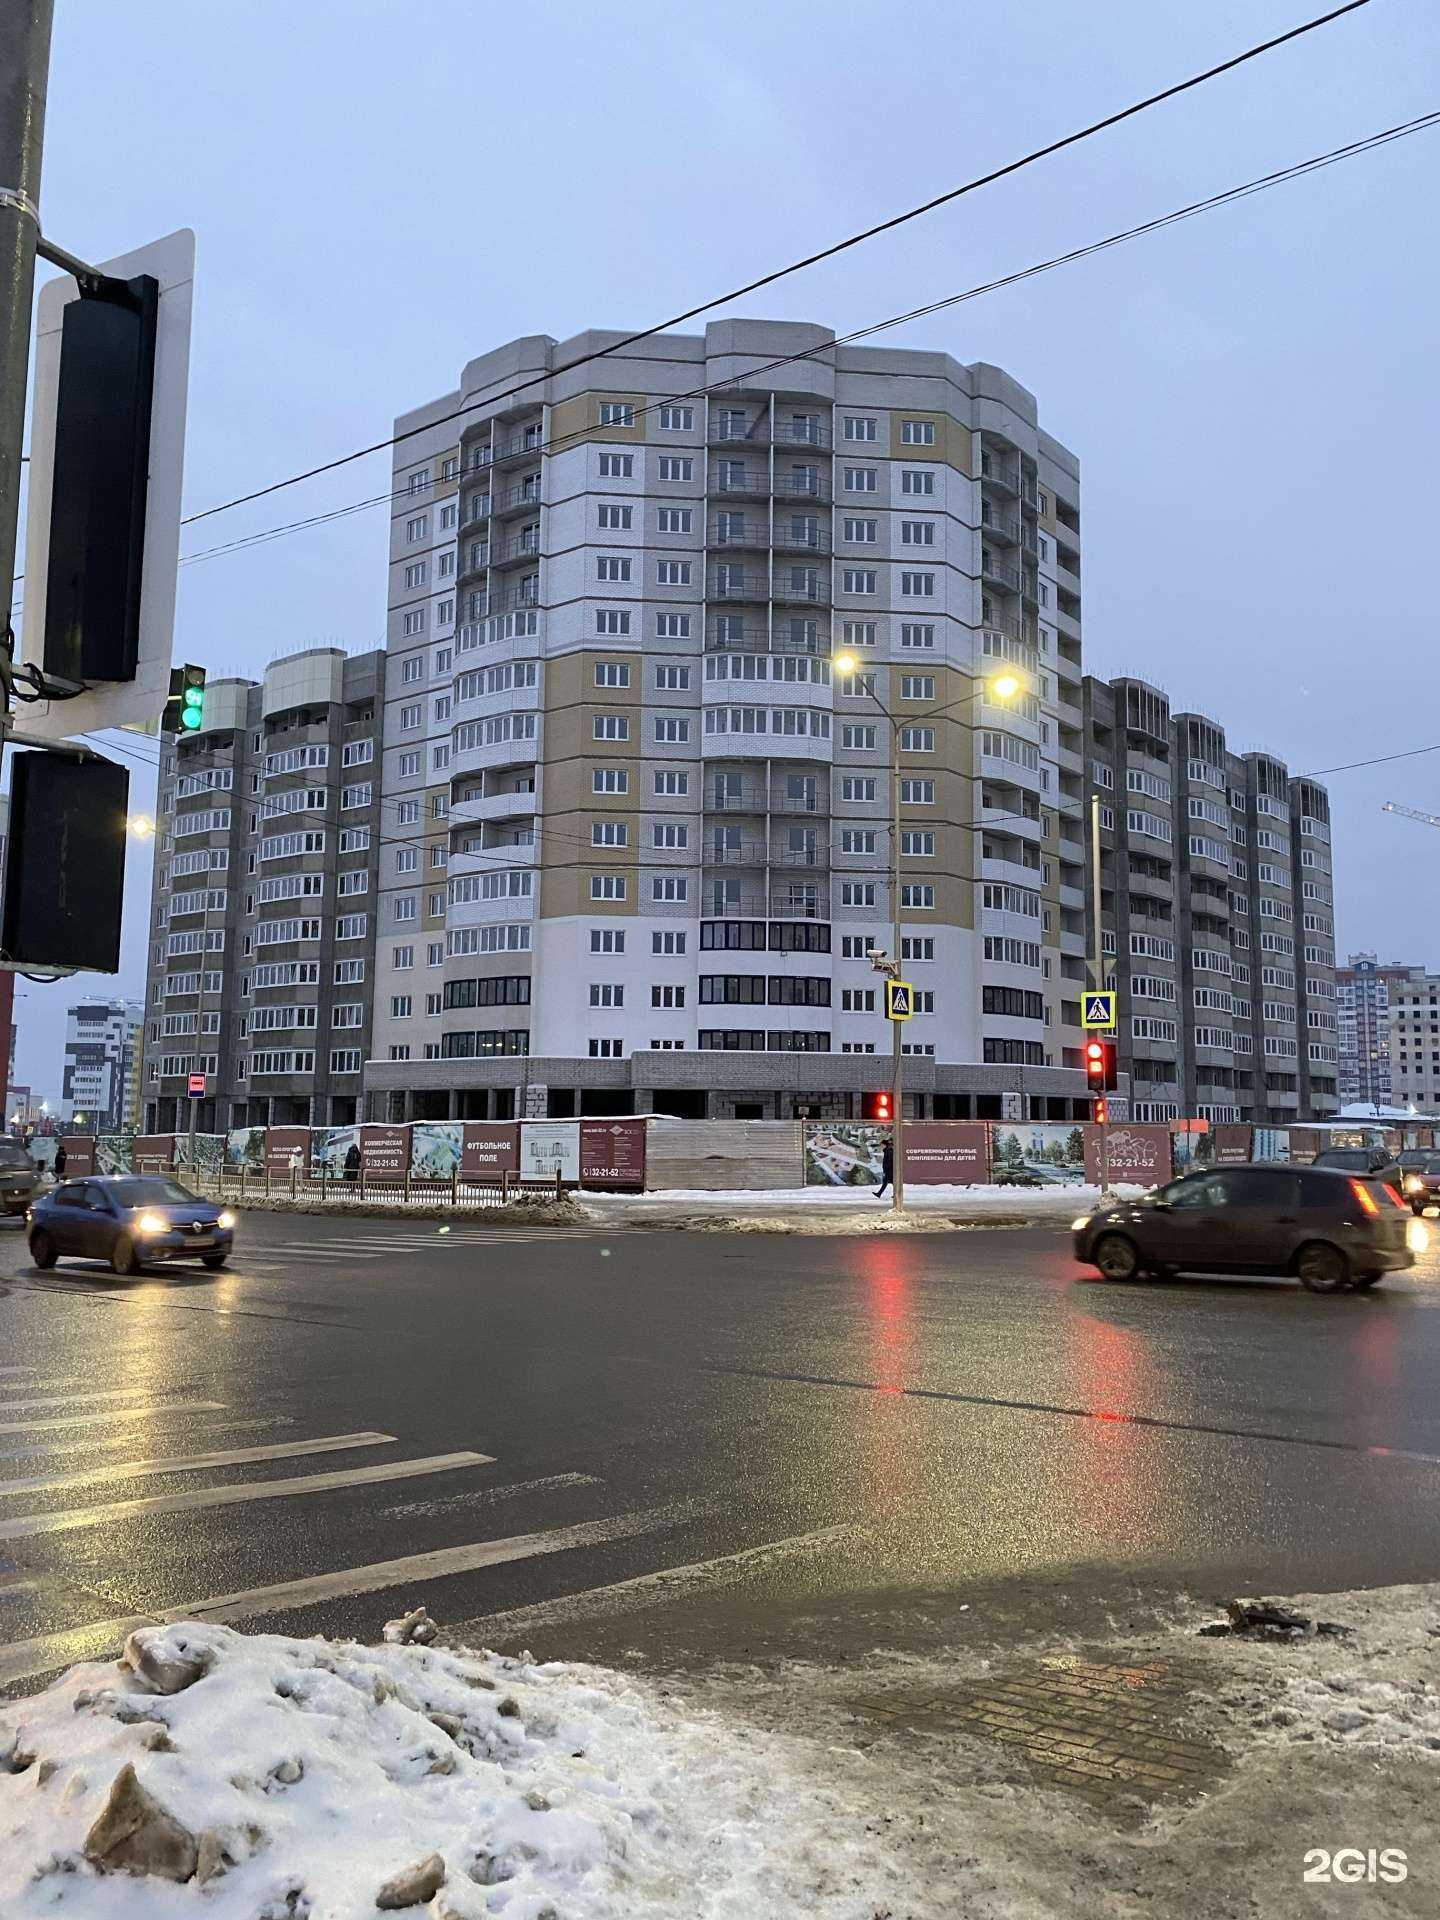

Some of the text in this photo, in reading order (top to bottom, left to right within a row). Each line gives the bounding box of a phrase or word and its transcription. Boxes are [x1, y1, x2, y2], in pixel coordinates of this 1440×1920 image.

[467, 1142, 511, 1150] ФУТБОЛЬНОЕ
[479, 1154, 498, 1162] ПОЛЕ
[1110, 1158, 1155, 1167] 32-21-52
